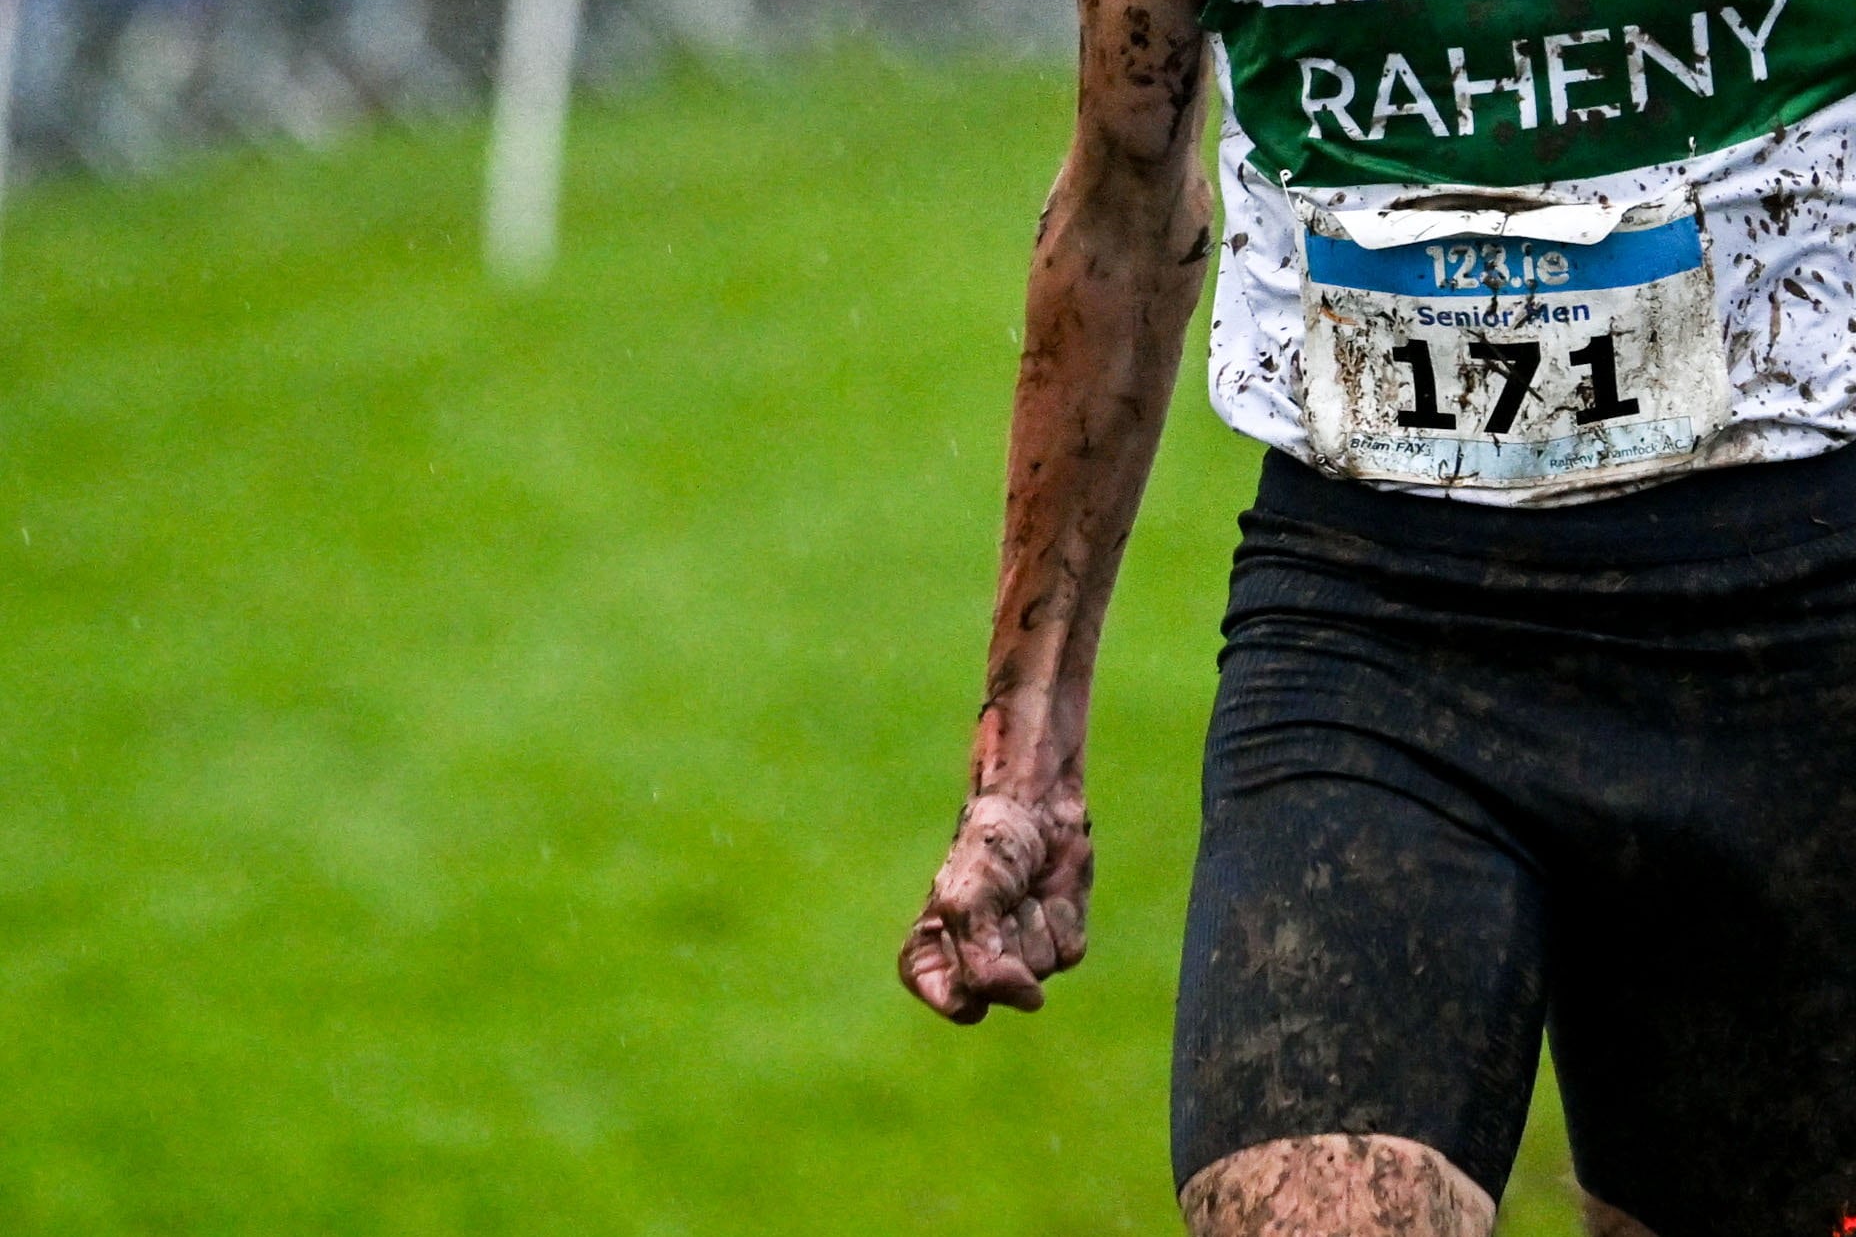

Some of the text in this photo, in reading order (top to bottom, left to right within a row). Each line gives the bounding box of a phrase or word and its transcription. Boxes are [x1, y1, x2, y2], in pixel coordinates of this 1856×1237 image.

[1425, 242, 1570, 290] 123.ie
[1417, 303, 1590, 327] Senior Men
[1392, 333, 1640, 434] 171
[1350, 438, 1425, 455] Brian FAY
[1599, 442, 1658, 460] hamrock
